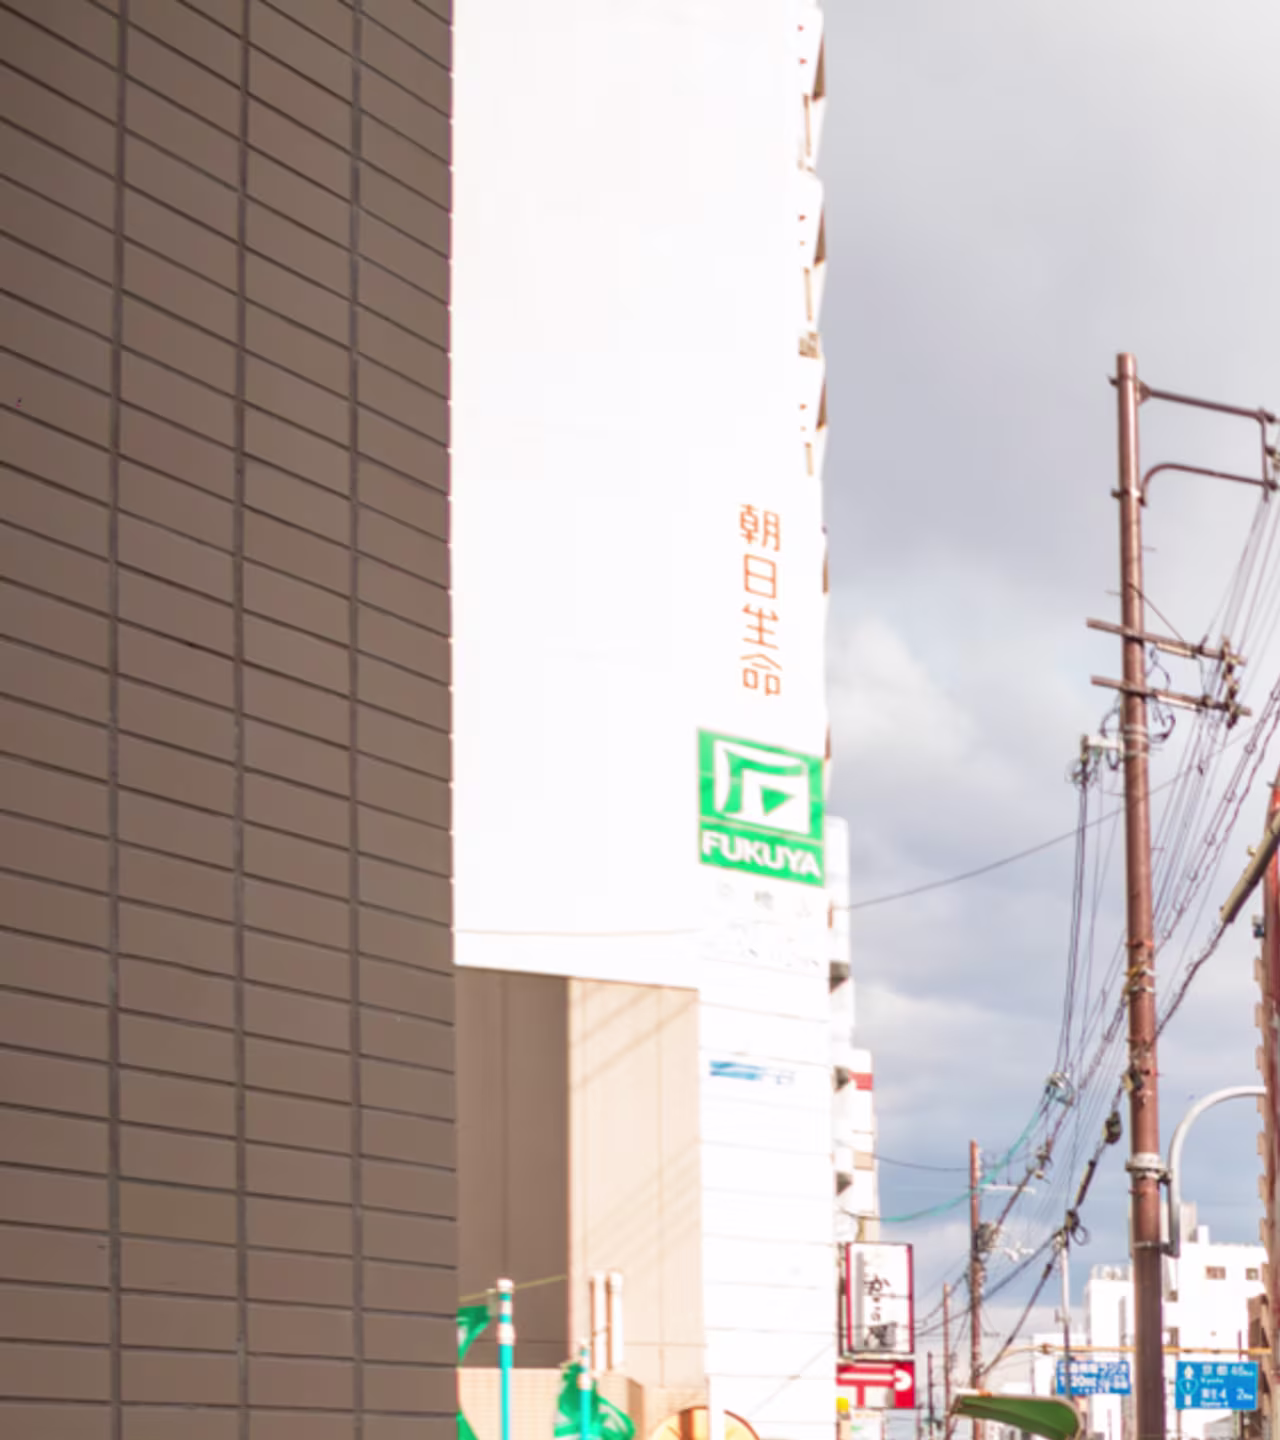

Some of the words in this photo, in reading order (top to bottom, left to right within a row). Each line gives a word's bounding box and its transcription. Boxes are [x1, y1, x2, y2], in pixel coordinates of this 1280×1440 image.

[739, 503, 782, 697] 朝日生命
[701, 830, 822, 878] FUKUYA
